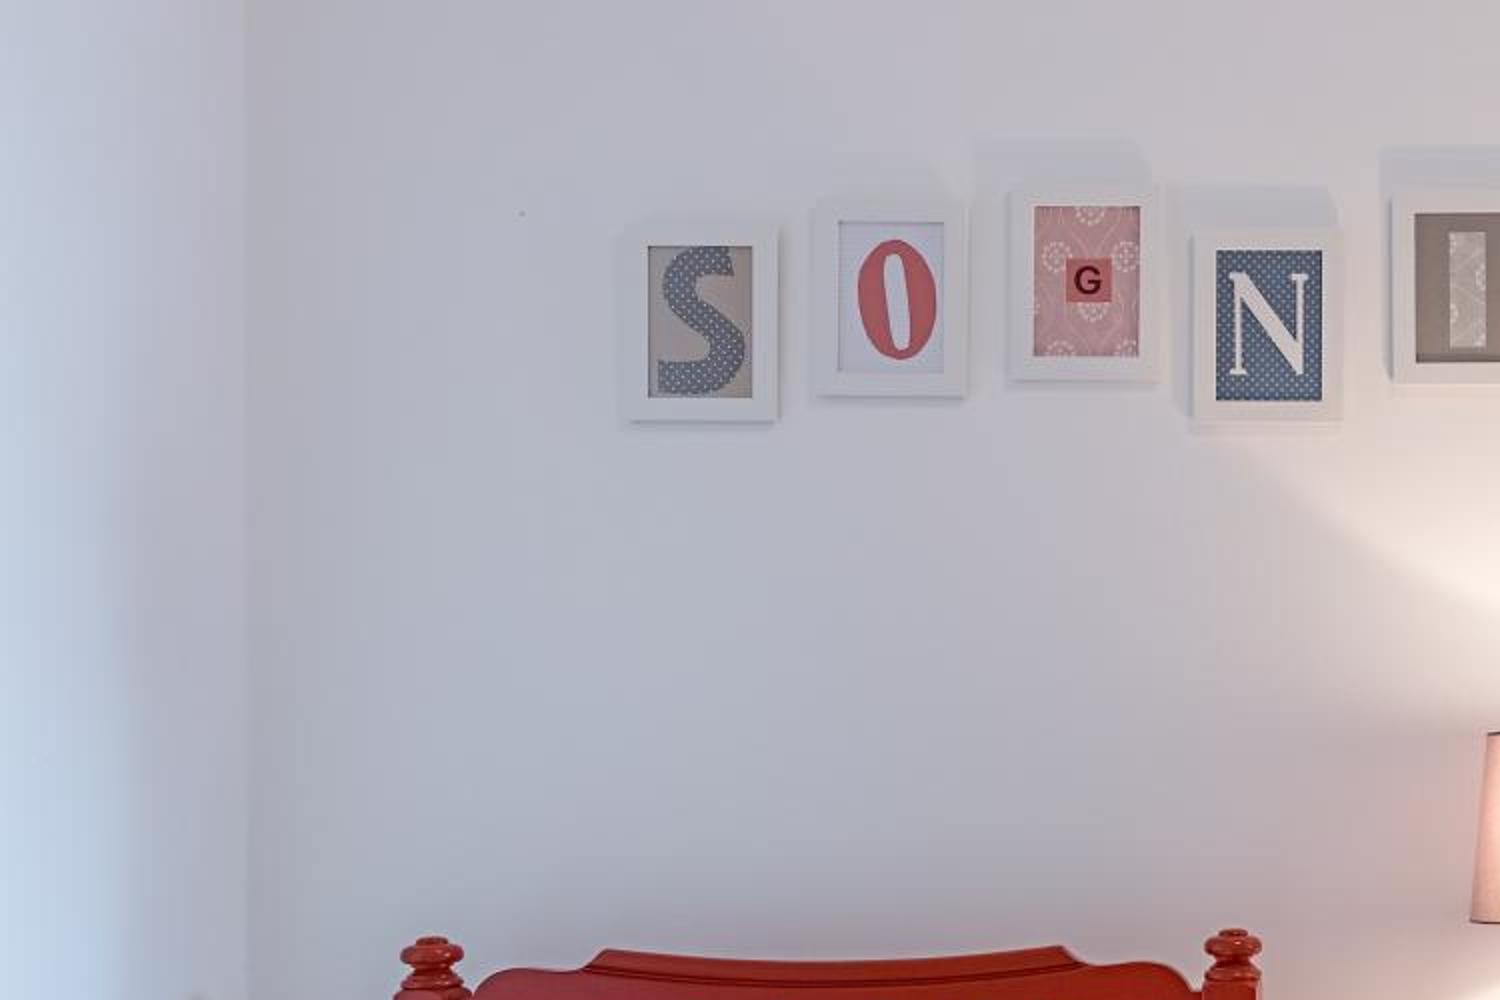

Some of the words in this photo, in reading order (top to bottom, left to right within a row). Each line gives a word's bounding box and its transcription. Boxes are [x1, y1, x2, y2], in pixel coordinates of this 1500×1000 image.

[659, 247, 745, 394] S
[1074, 265, 1102, 295] G
[1231, 272, 1310, 376] N
